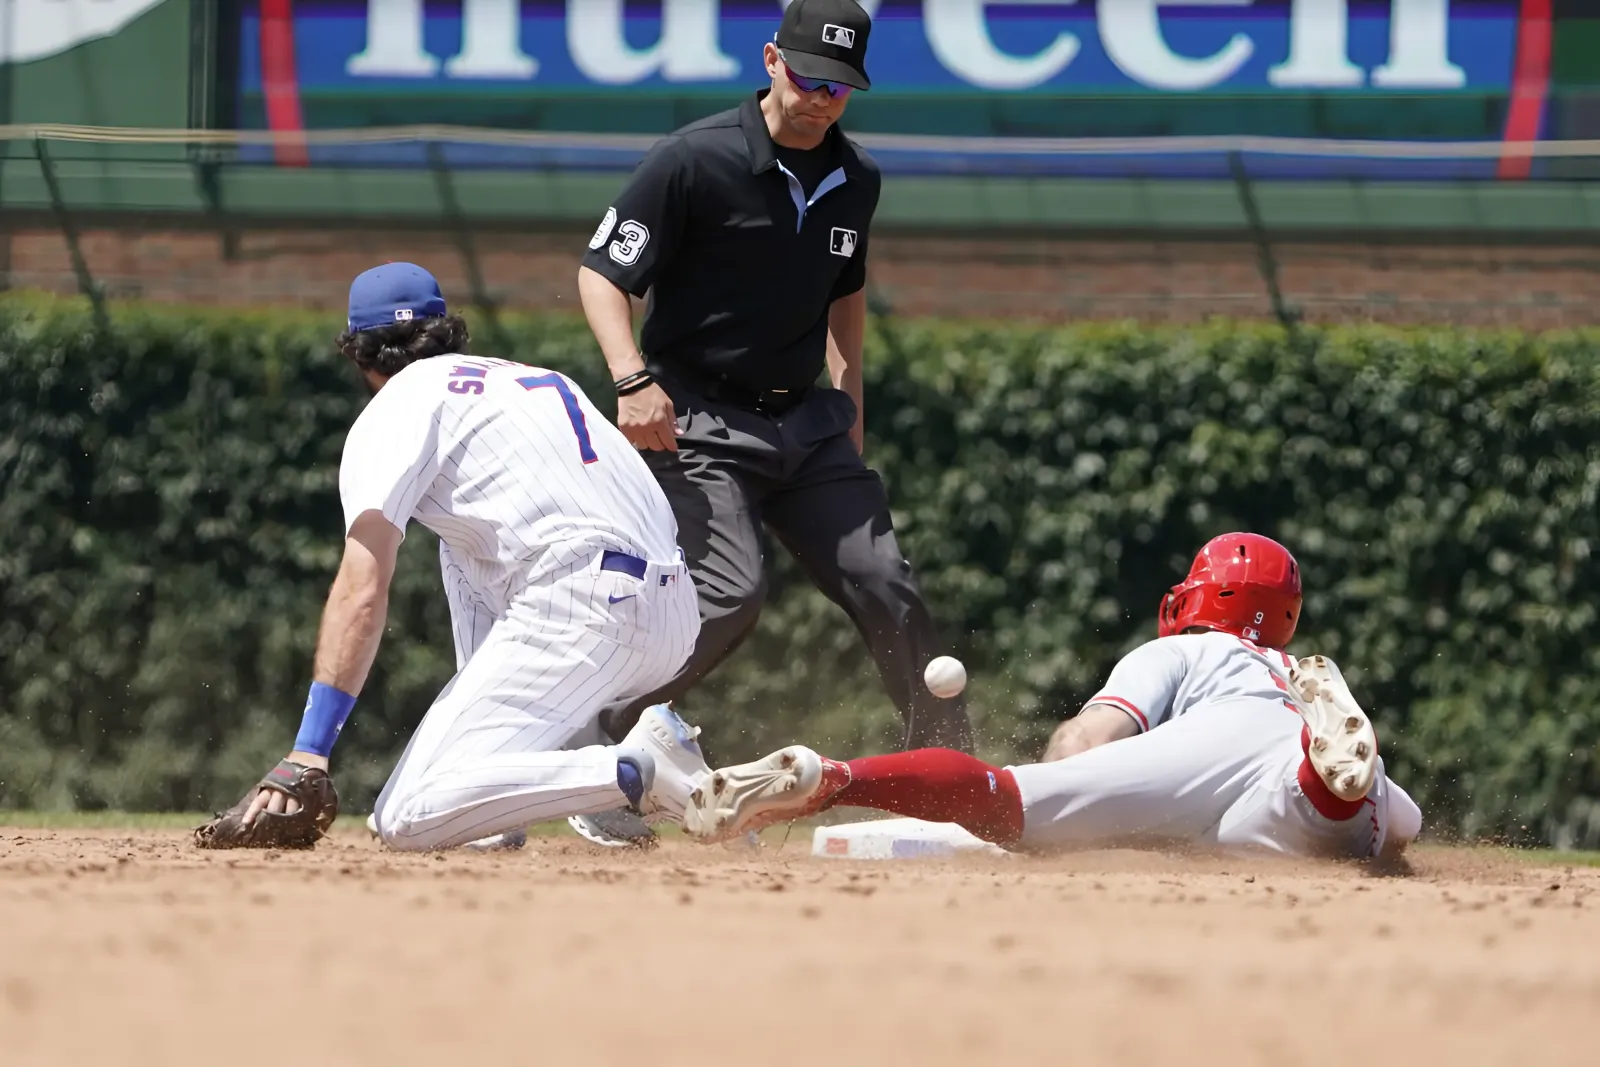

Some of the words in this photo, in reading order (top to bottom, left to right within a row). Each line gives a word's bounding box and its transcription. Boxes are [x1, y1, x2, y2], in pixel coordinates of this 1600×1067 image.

[346, 0, 1467, 90] nueen
[514, 372, 599, 464] 7
[1254, 611, 1264, 625] 9
